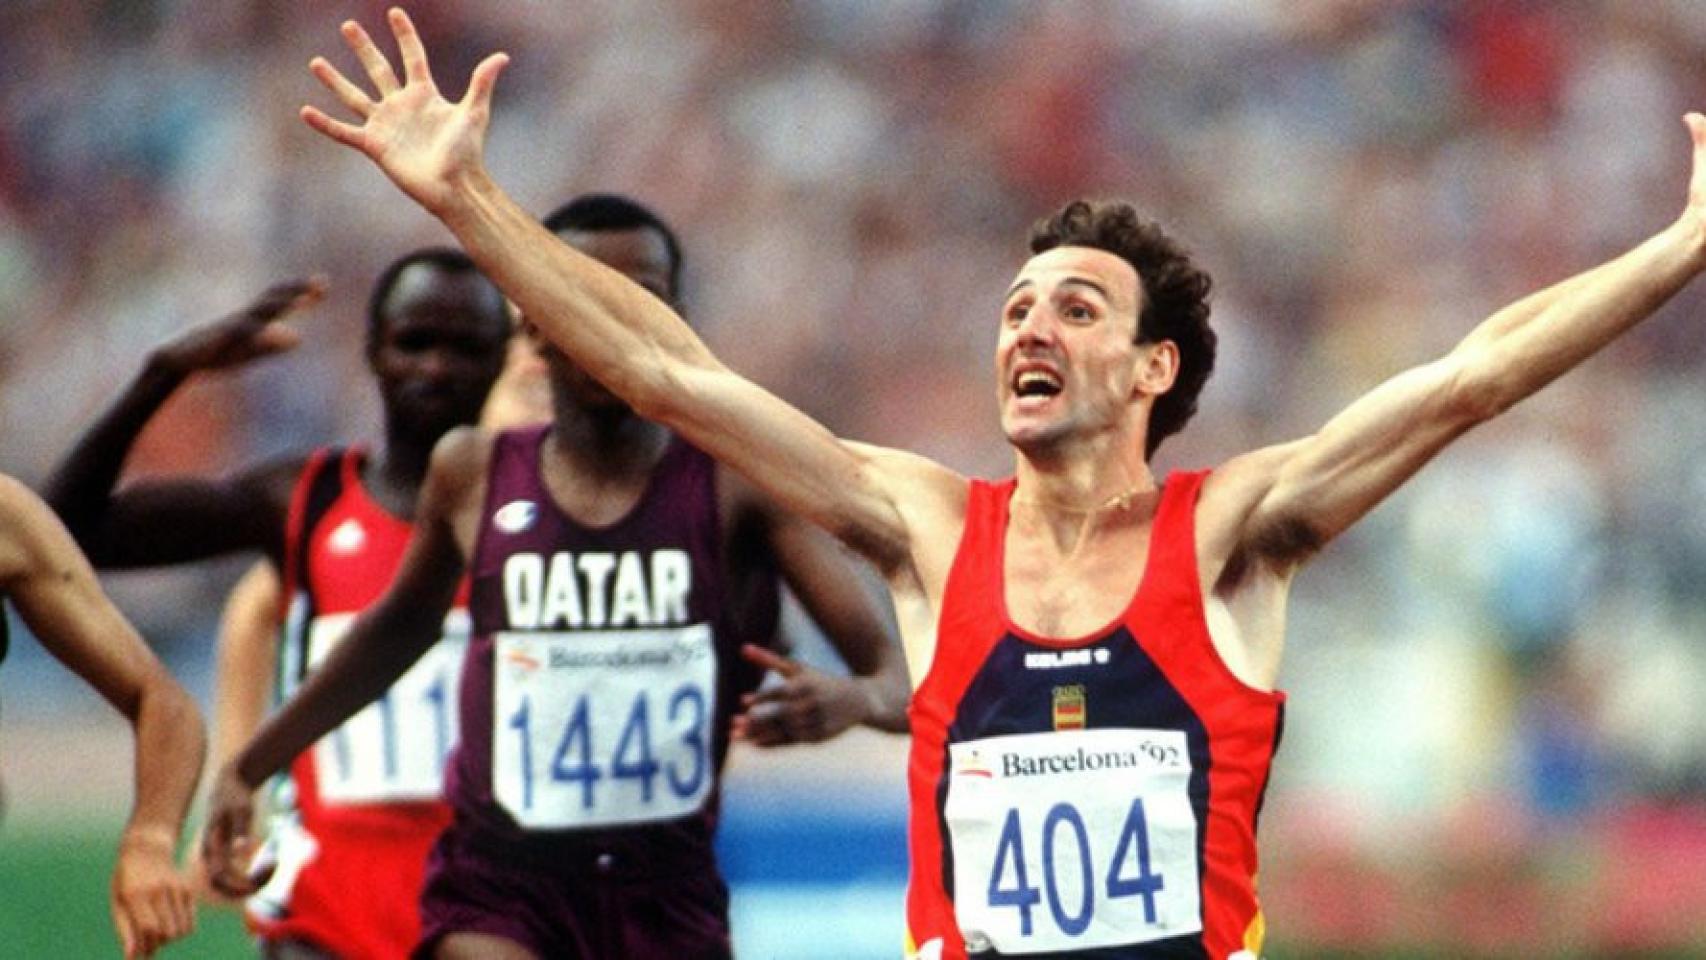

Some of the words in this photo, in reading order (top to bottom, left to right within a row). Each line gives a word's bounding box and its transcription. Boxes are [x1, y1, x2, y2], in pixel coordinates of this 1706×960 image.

[503, 549, 691, 628] QATAR
[508, 682, 706, 810] 1443
[1002, 746, 1136, 777] Barcelona
[987, 796, 1164, 938] 404
